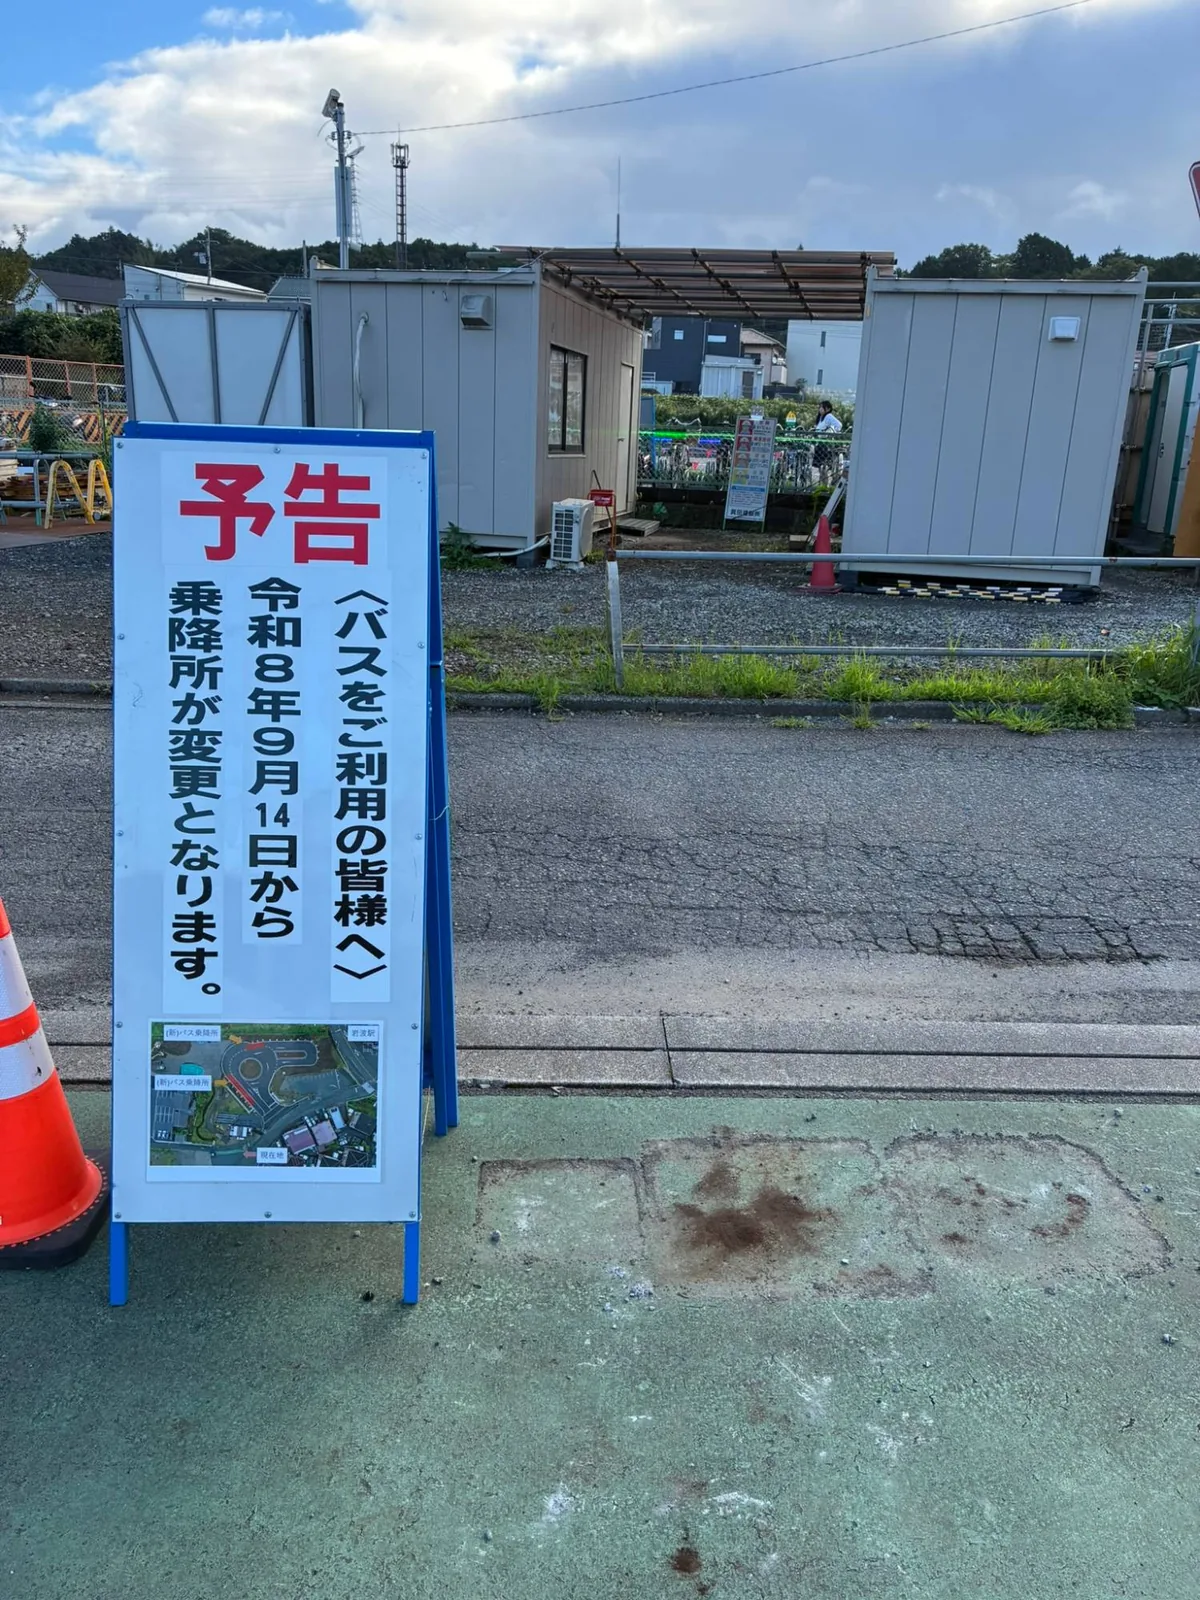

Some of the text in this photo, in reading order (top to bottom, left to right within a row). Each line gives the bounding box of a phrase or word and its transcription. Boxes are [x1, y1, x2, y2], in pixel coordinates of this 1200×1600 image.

[179, 461, 381, 566] 予告
[168, 580, 224, 995] 乗降所が変更となります。
[246, 576, 302, 939] 令和8年9月14日から
